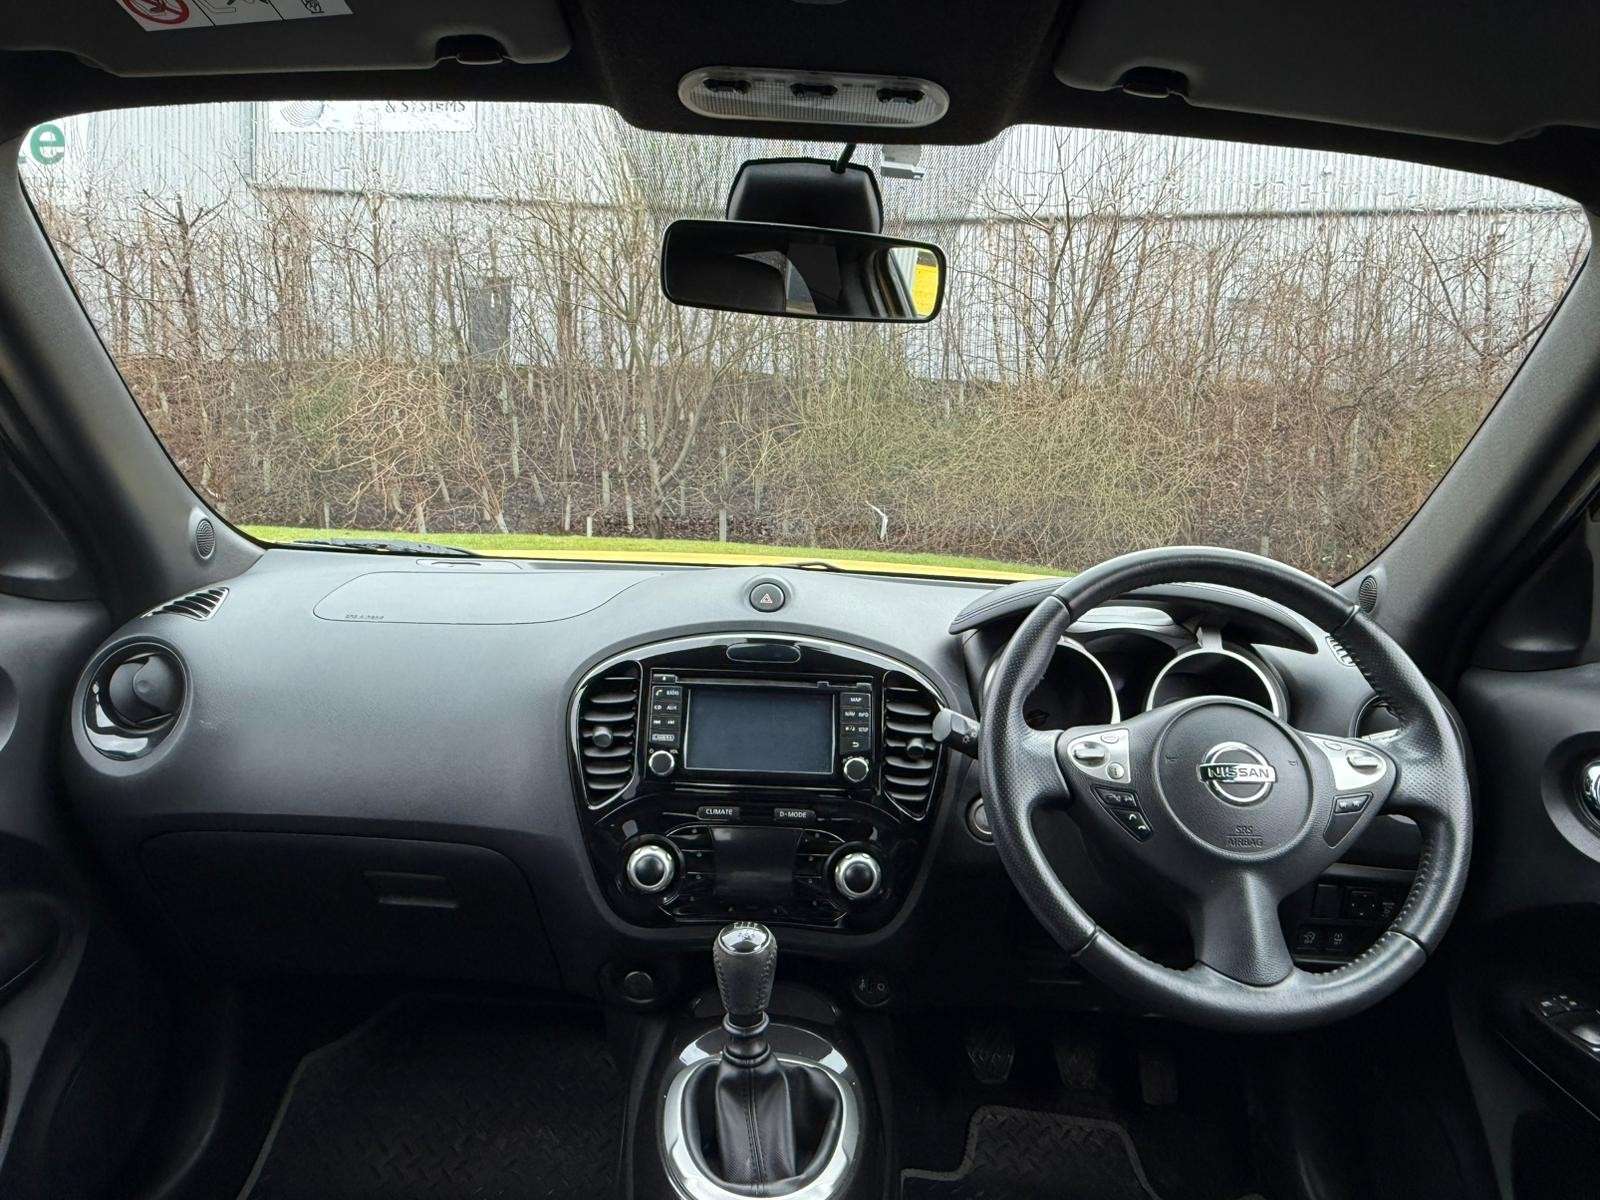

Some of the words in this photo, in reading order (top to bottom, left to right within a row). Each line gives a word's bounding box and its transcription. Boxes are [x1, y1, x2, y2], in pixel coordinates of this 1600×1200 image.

[18, 124, 65, 166] e
[1207, 766, 1270, 779] NISSAN
[1234, 825, 1255, 835] SRS
[1225, 837, 1264, 848] AIRBAG
